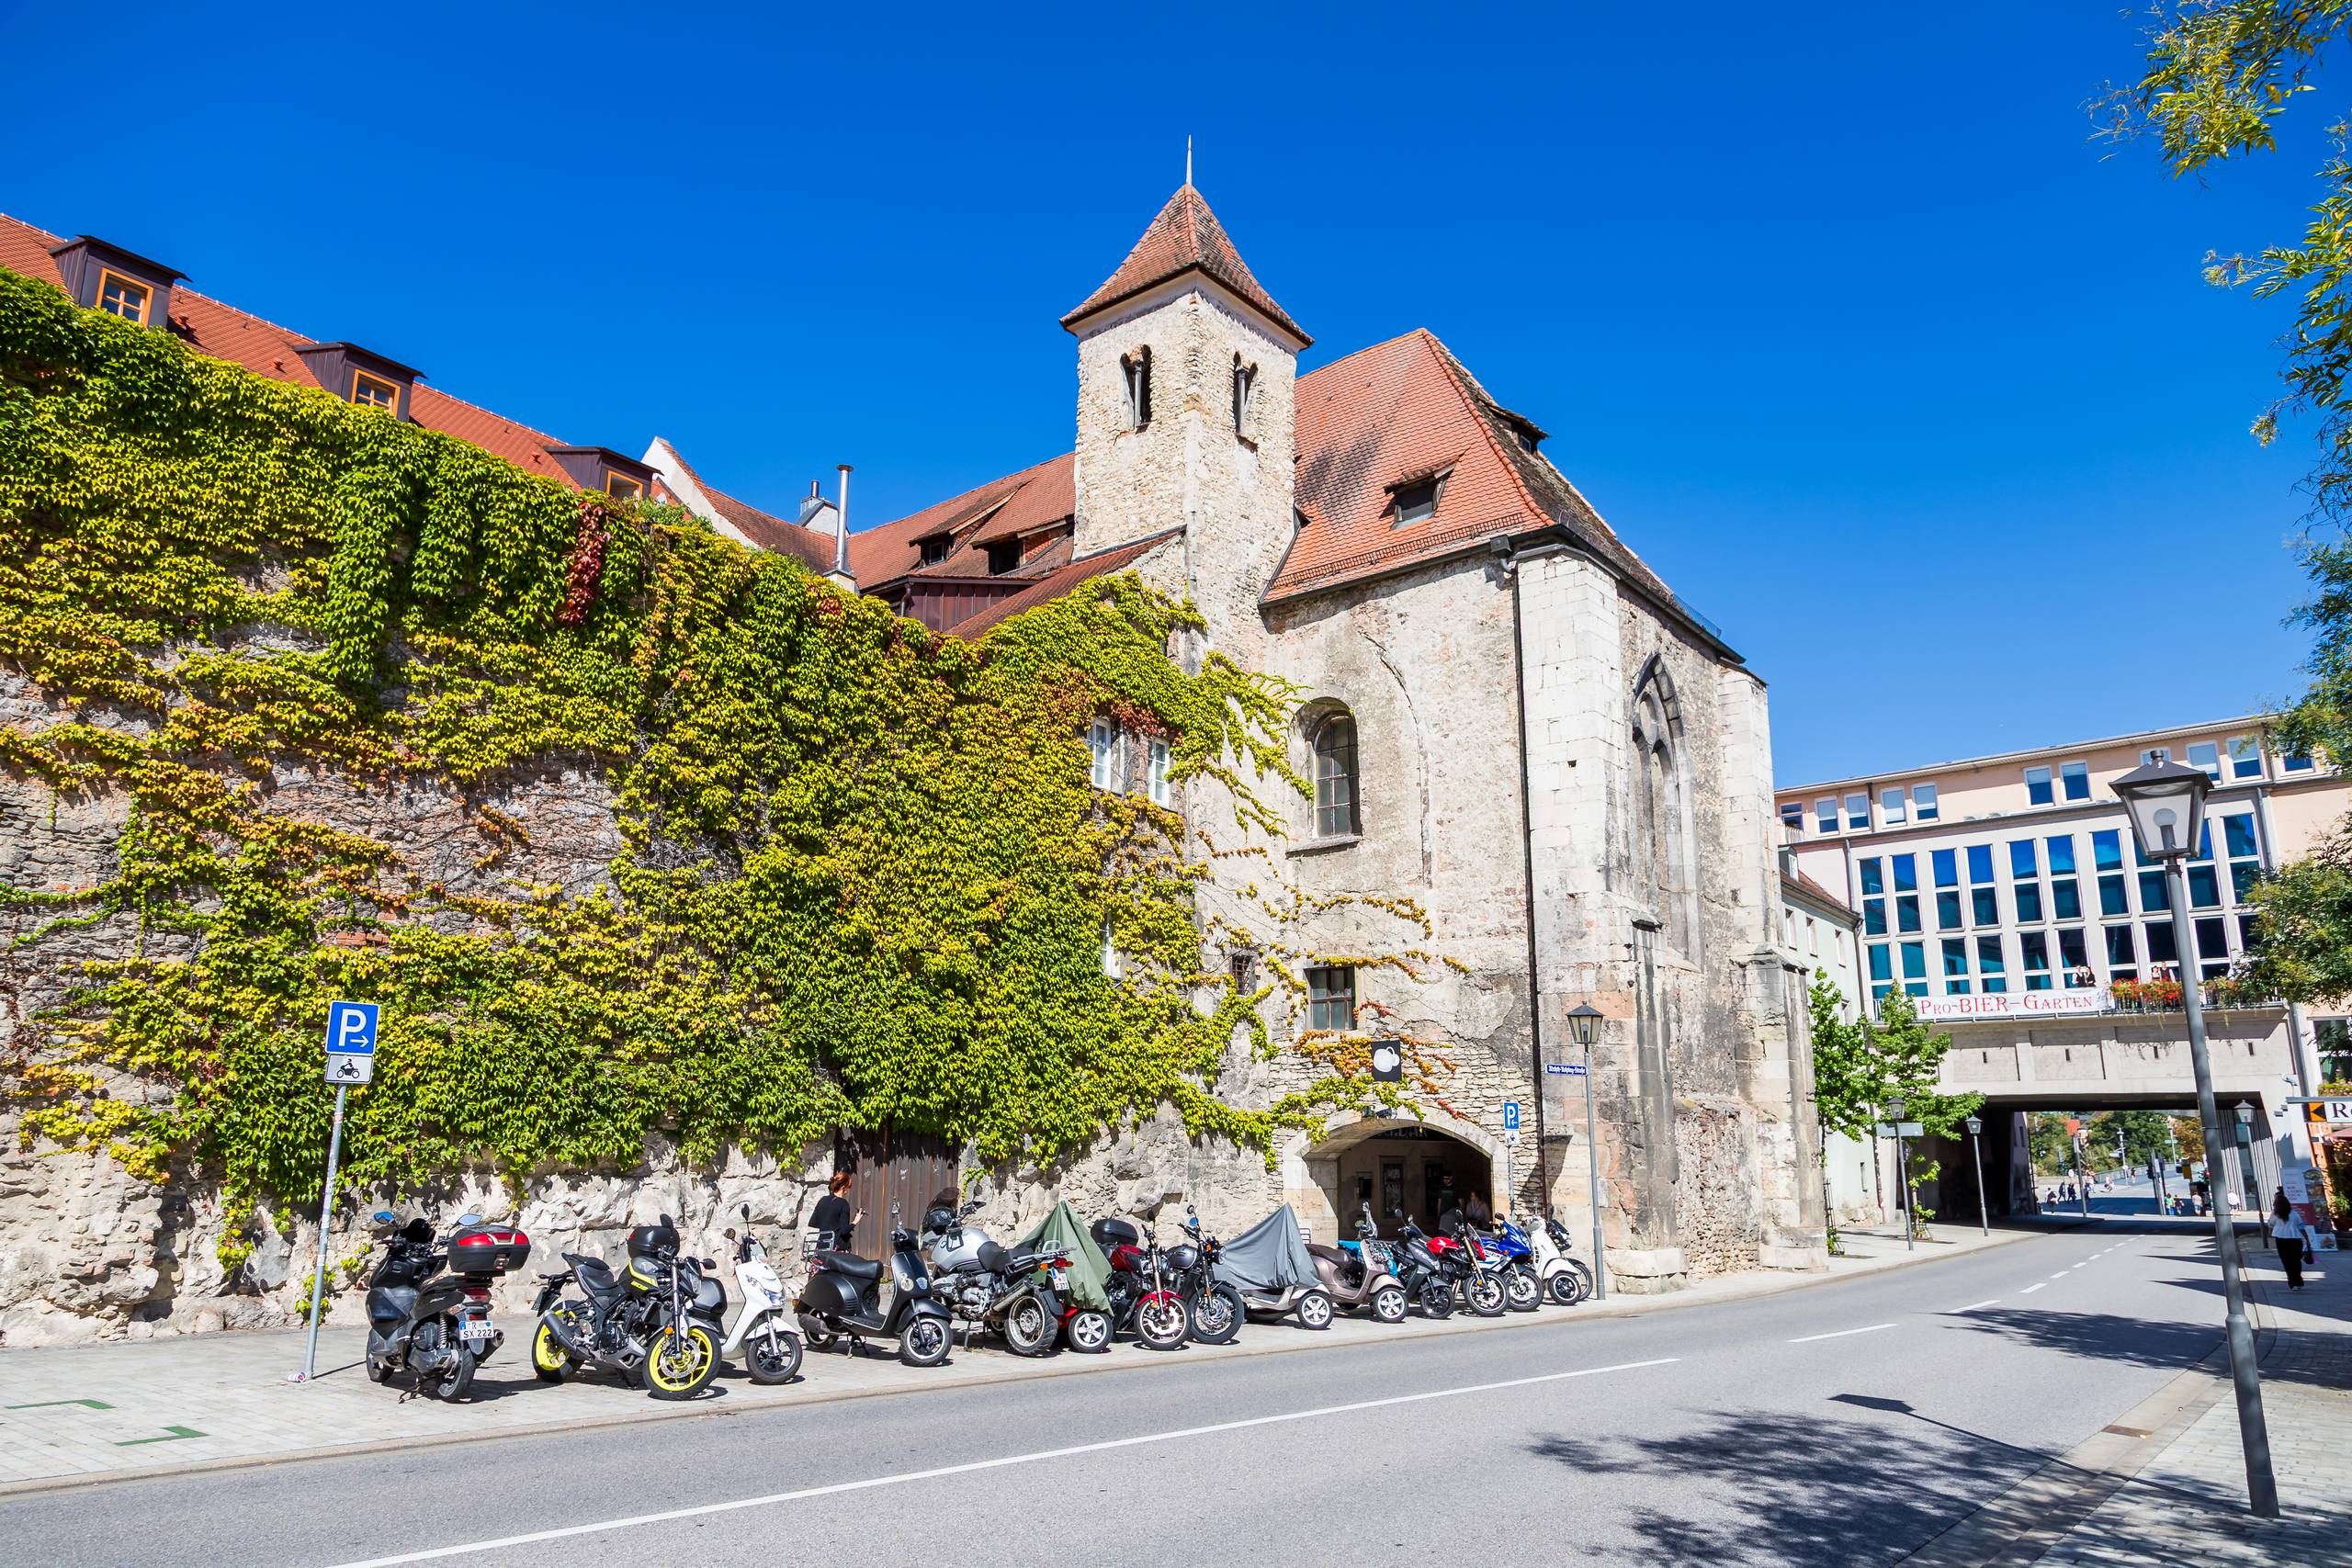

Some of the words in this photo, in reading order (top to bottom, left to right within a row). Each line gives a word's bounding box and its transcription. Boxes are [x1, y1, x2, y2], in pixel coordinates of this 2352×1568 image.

[338, 1009, 367, 1046] P
[1507, 1105, 1516, 1126] P
[2332, 1102, 2352, 1118] R
[463, 1330, 474, 1338] SX
[477, 1329, 492, 1337] 222
